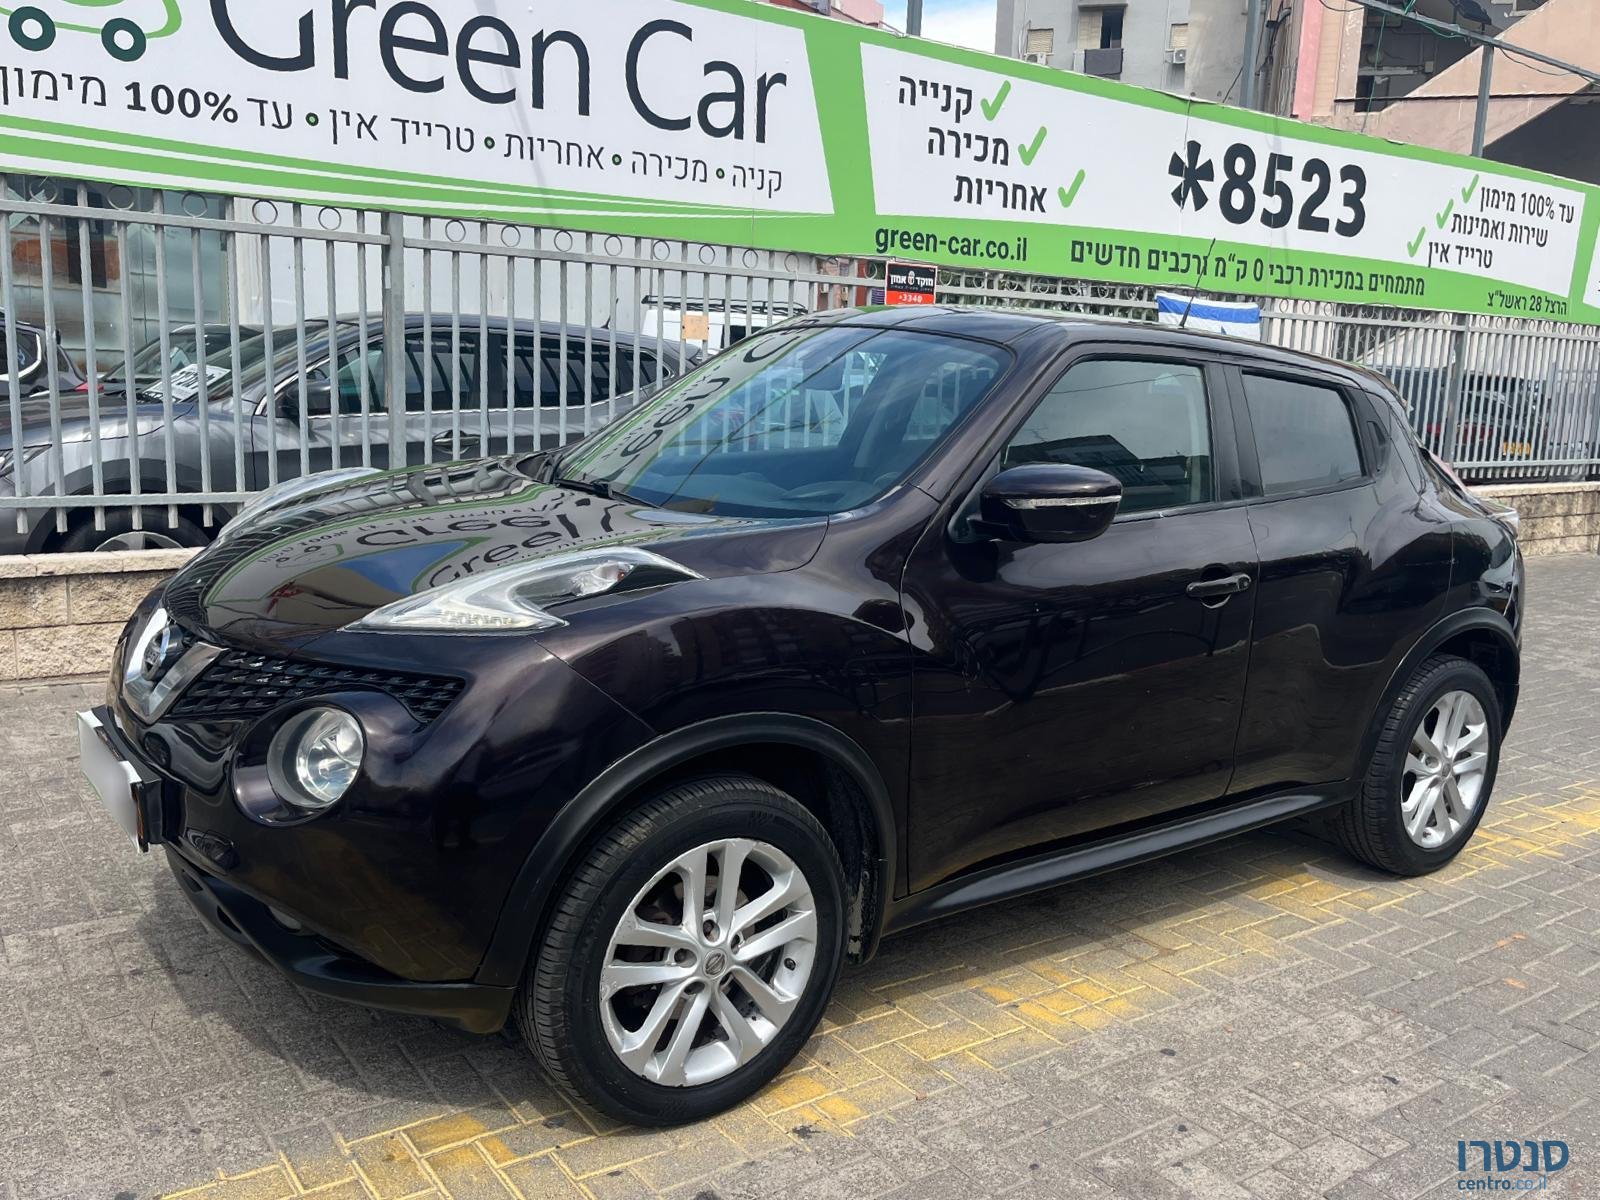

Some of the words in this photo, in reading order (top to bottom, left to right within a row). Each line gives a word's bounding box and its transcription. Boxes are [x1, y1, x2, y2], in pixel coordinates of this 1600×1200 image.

[0, 66, 106, 106] מימון
[208, 0, 589, 119] Green
[626, 19, 786, 143] Car
[125, 82, 238, 123] 100%
[247, 98, 292, 129] עד
[899, 76, 972, 123] קנייה
[330, 109, 377, 144] אין
[391, 118, 474, 152] טרייד
[504, 134, 604, 169] אחריות
[929, 127, 1008, 166] מכירה
[632, 151, 707, 182] מכירה
[733, 165, 781, 198] קניה
[954, 175, 1047, 212] אחריות
[1481, 187, 1515, 212] מימון
[1522, 193, 1554, 219] 100%
[1559, 204, 1574, 223] עד
[1452, 214, 1504, 240] ואמינות
[1508, 224, 1548, 247] שירות
[876, 229, 1026, 261] green-car.co.il
[1071, 241, 1139, 268] חדשים
[1428, 242, 1450, 268] אין
[1456, 246, 1492, 268] טרייד
[1253, 258, 1263, 281] 0
[1269, 264, 1303, 285] רכבי
[1308, 268, 1363, 290] במכירת
[1369, 274, 1424, 295] מתמחים
[1530, 295, 1542, 312] 28
